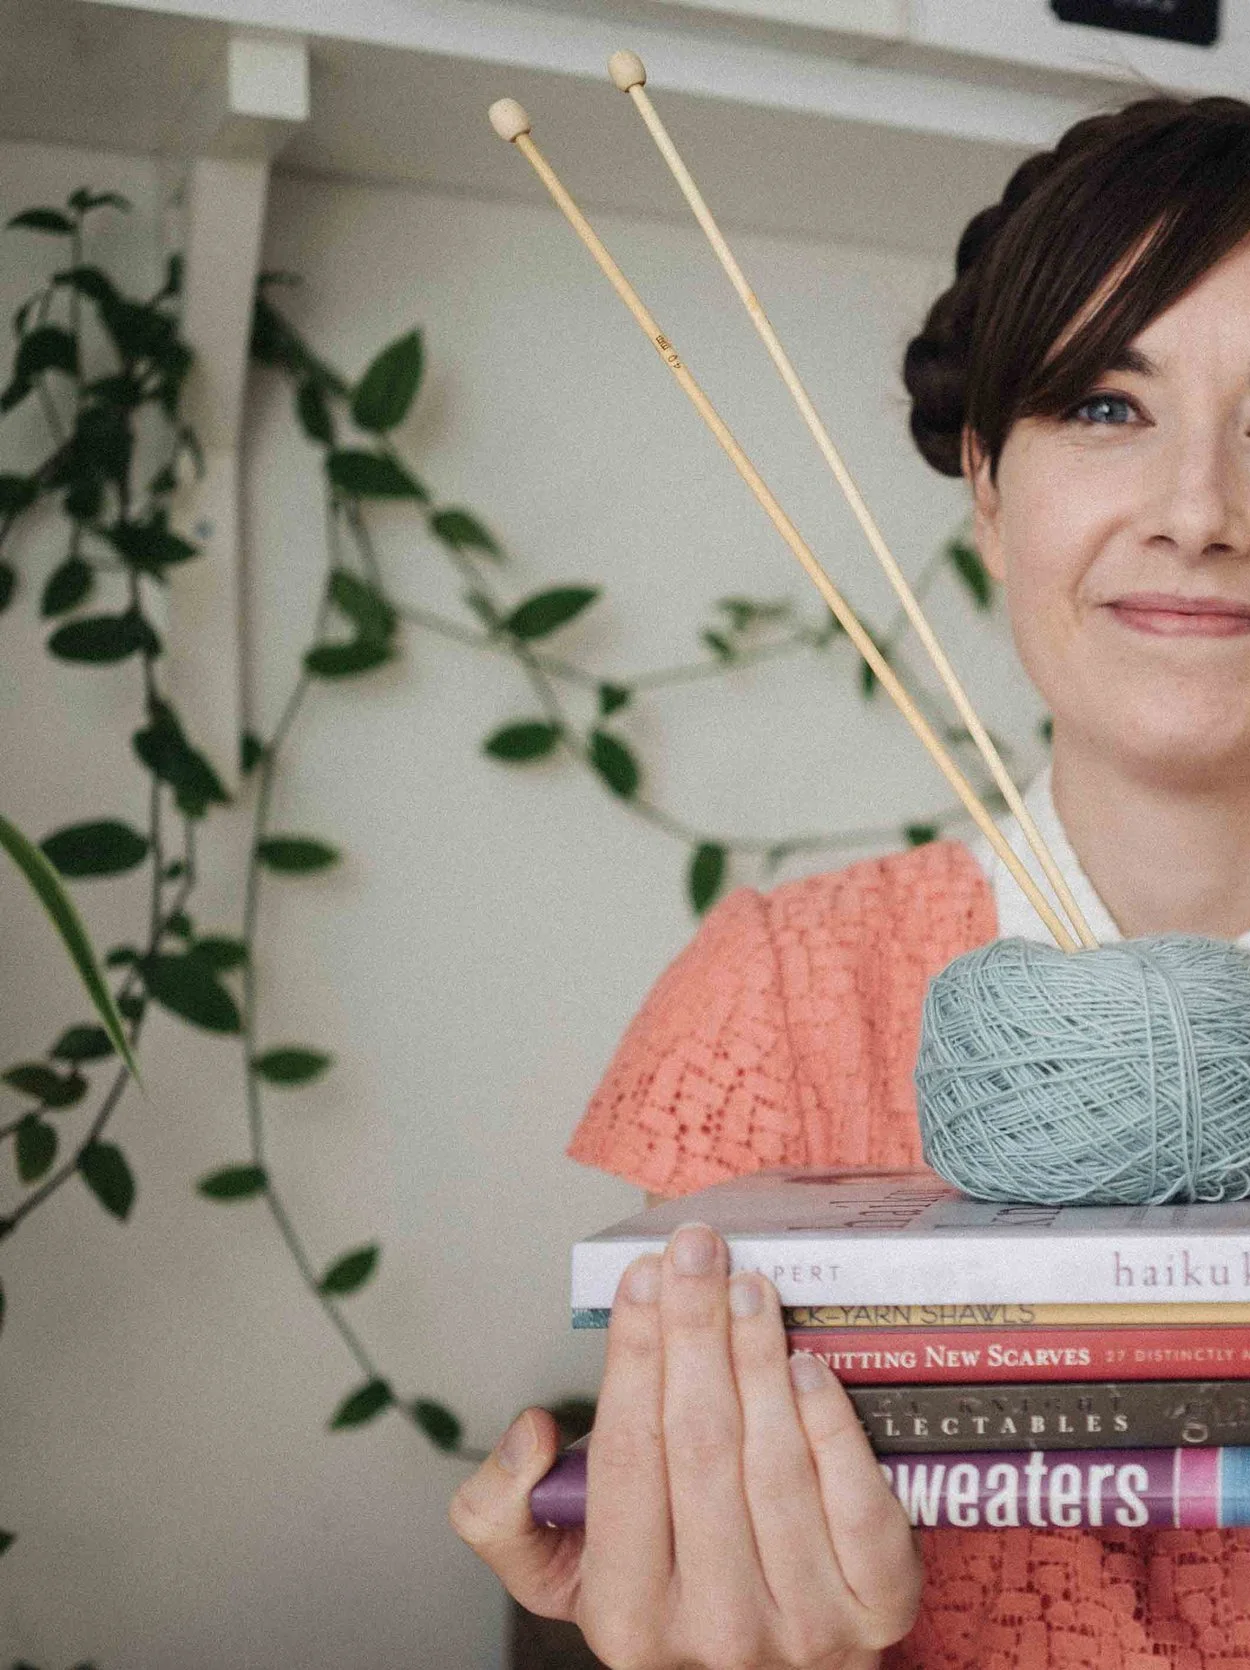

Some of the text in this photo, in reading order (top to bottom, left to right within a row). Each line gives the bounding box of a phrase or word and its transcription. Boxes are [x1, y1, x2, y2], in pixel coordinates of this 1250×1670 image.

[740, 1265, 840, 1283] PERT
[1113, 1251, 1231, 1288] haiku
[787, 1304, 1036, 1325] CK-YARN SHAWLS
[792, 1347, 917, 1369] NITTING
[1105, 1351, 1126, 1363] 27
[1134, 1349, 1235, 1362] DISTINCTLY
[862, 1414, 1128, 1436] LECTABLES
